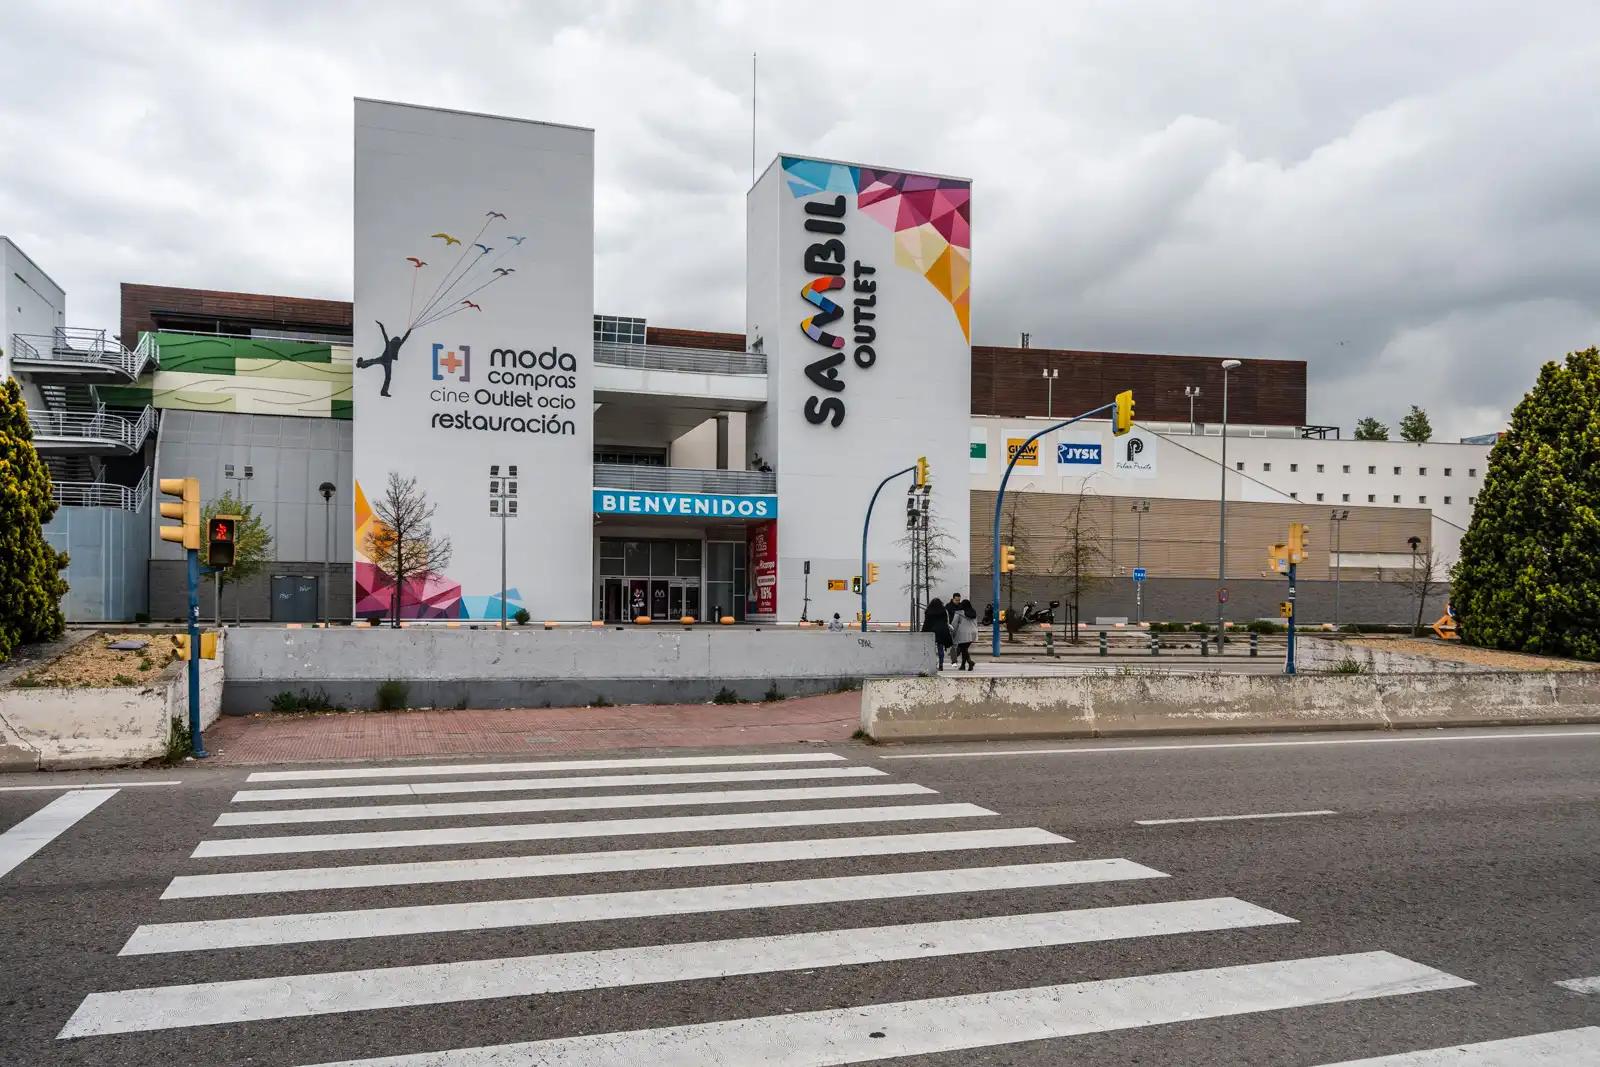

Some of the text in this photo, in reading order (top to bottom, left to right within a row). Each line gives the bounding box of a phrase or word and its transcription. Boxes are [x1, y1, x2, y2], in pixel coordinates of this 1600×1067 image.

[801, 195, 847, 428] SAMBIL
[854, 260, 877, 369] OUTLET
[489, 346, 577, 372] moda
[488, 370, 576, 390] compras
[430, 387, 576, 410] cine Outlet ocio
[431, 410, 576, 435] restauración
[1066, 448, 1099, 460] JYSK
[602, 495, 768, 516] BIENVENIDOS
